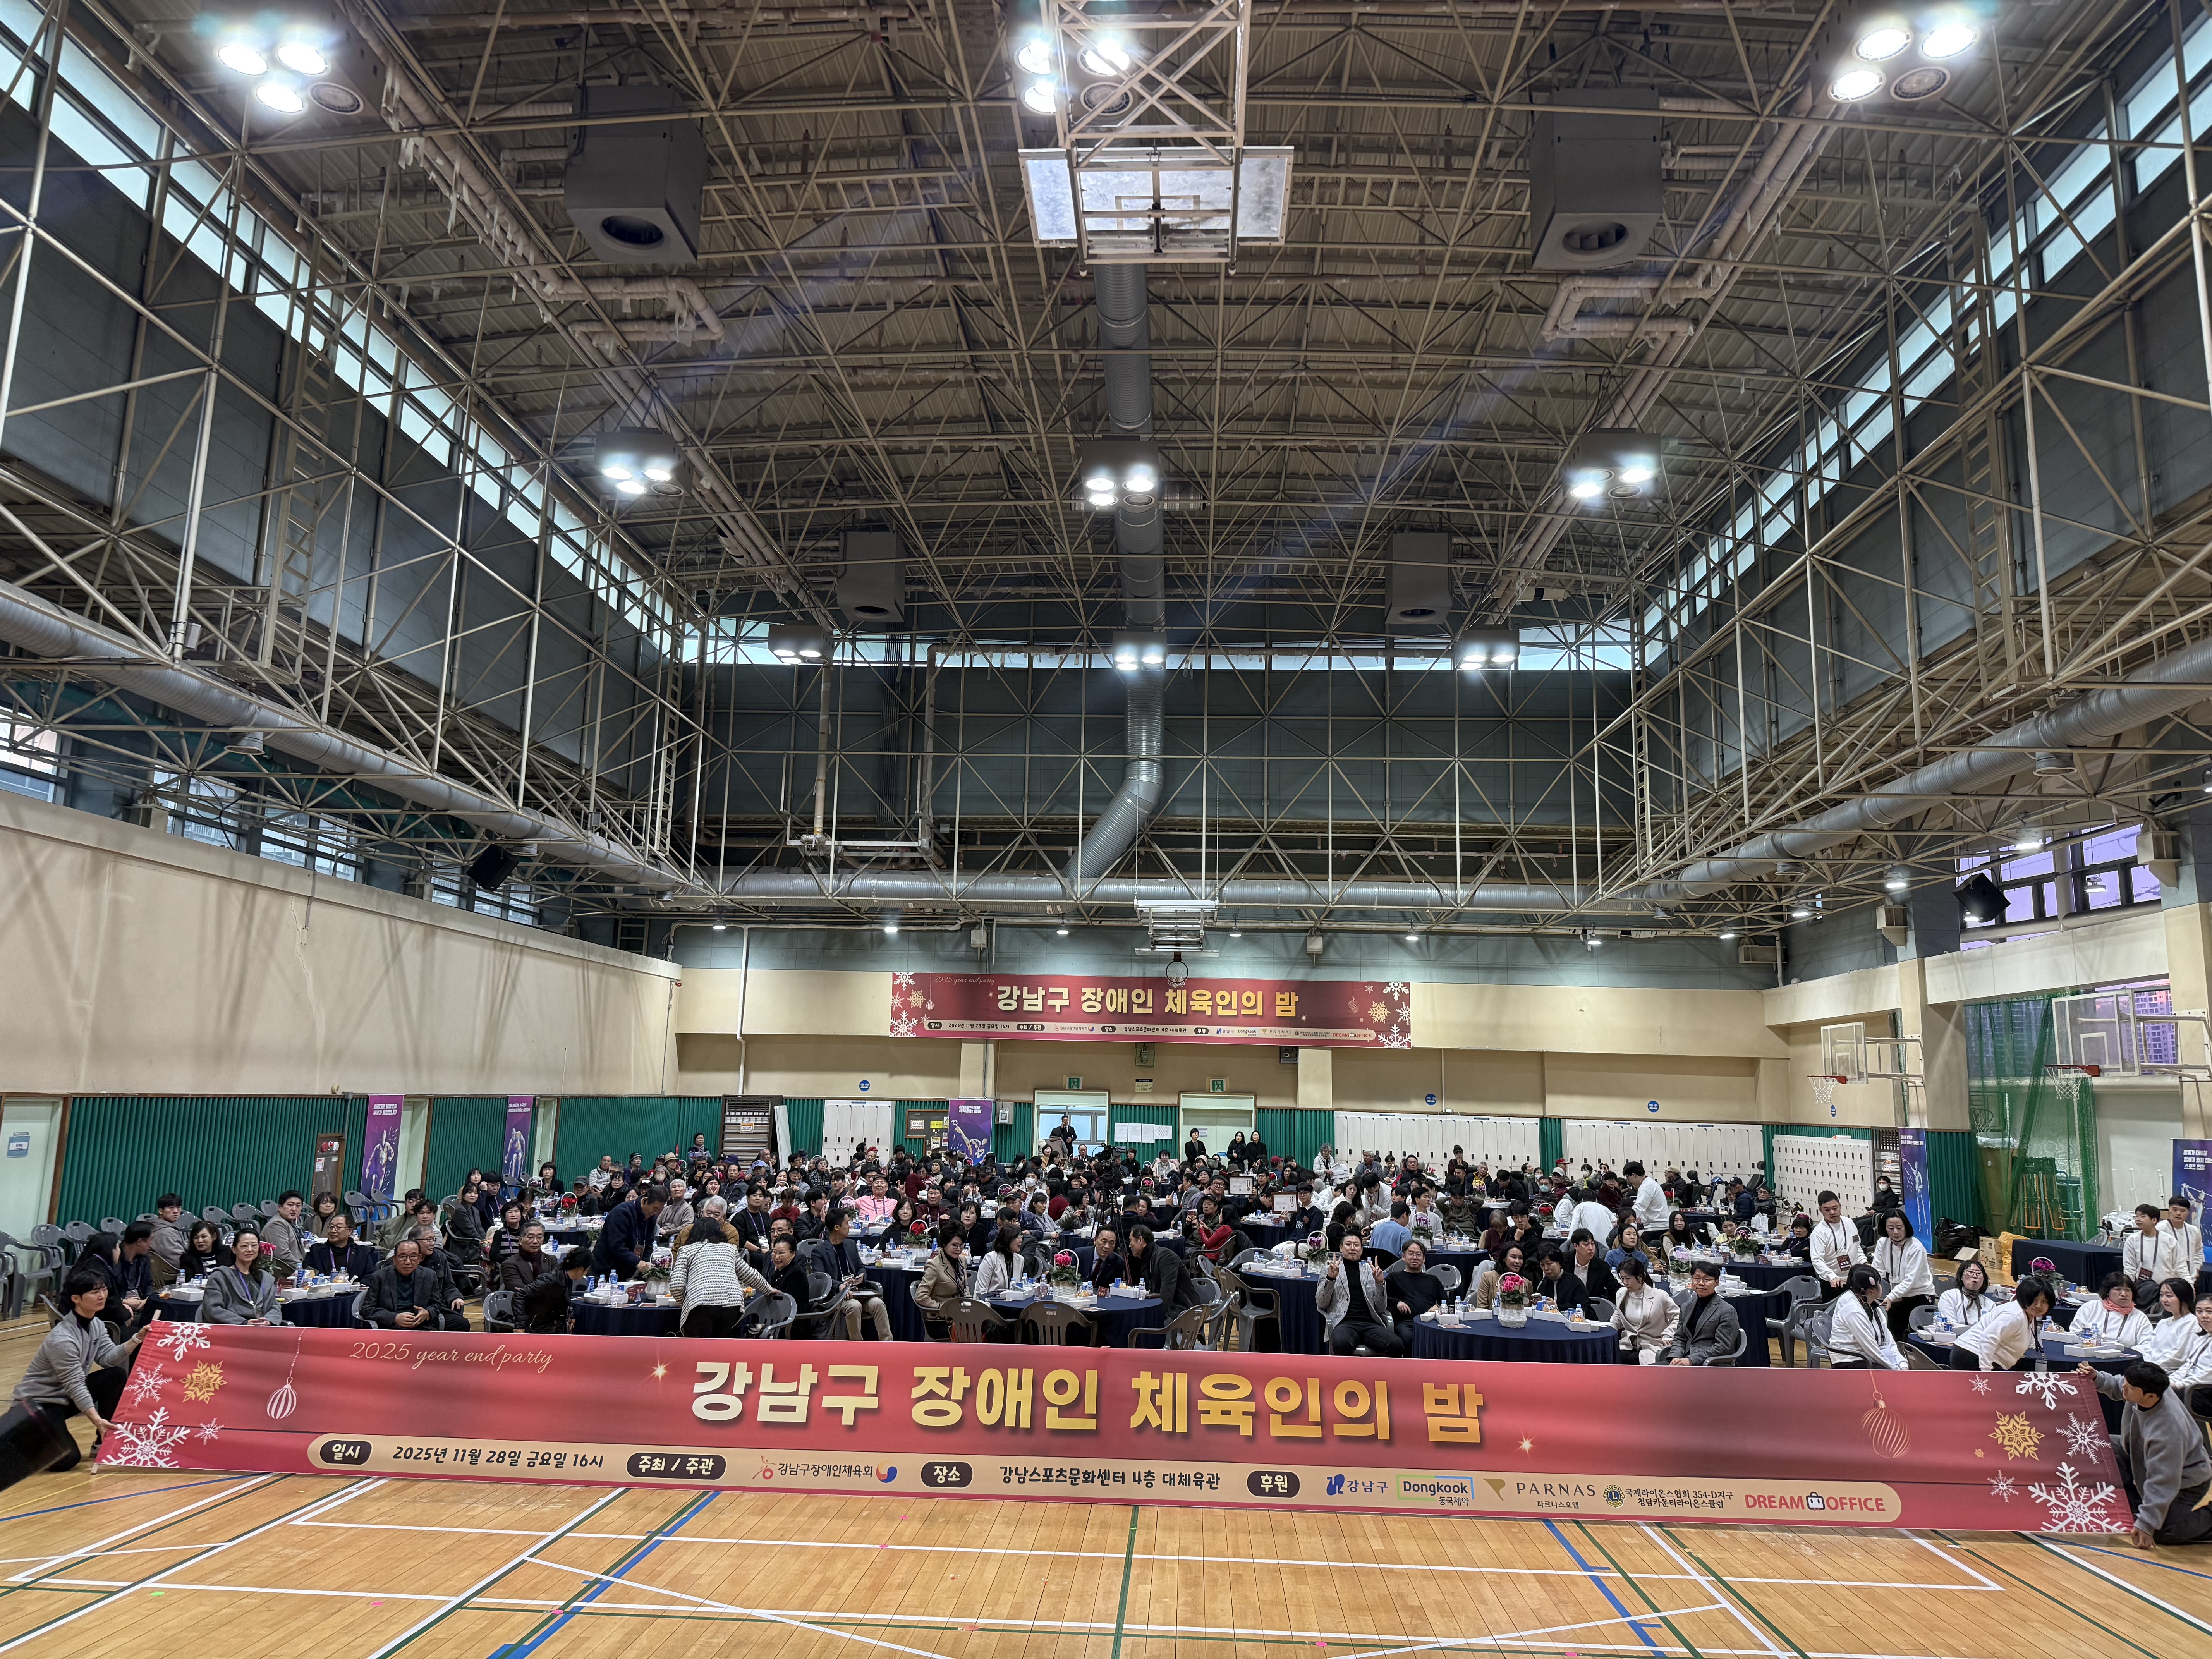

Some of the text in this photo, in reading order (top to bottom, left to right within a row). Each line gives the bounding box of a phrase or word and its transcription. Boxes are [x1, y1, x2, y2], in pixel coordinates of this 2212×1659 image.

[998, 986, 1298, 1017] 강남구 장애인 체육인의 밤
[349, 1342, 554, 1373] 2025 year end party
[692, 1361, 1484, 1444] 강남구 장애인 체육인의 밤
[332, 1444, 360, 1460] 일시
[393, 1446, 603, 1468] 2025년 11월 28일 금요일 16시
[638, 1456, 714, 1475] 주최 / 주관
[778, 1463, 873, 1478] 강남구장애인체육회
[933, 1465, 961, 1484] 장소
[1000, 1466, 1220, 1490] 강남스포츠문화센터 4층 대체육관
[1260, 1474, 1288, 1492] 후원
[1346, 1480, 1389, 1494] 강남구
[1403, 1481, 1468, 1496] Dongkook
[1516, 1482, 1595, 1497] PARNAS
[1625, 1488, 1734, 1500] 국제라이온스협회 354-D지구
[1439, 1496, 1469, 1506] 동국제약
[1638, 1498, 1724, 1509] 청담카운티라이온스클럽
[1745, 1494, 1886, 1511] DREAM OFFICE
